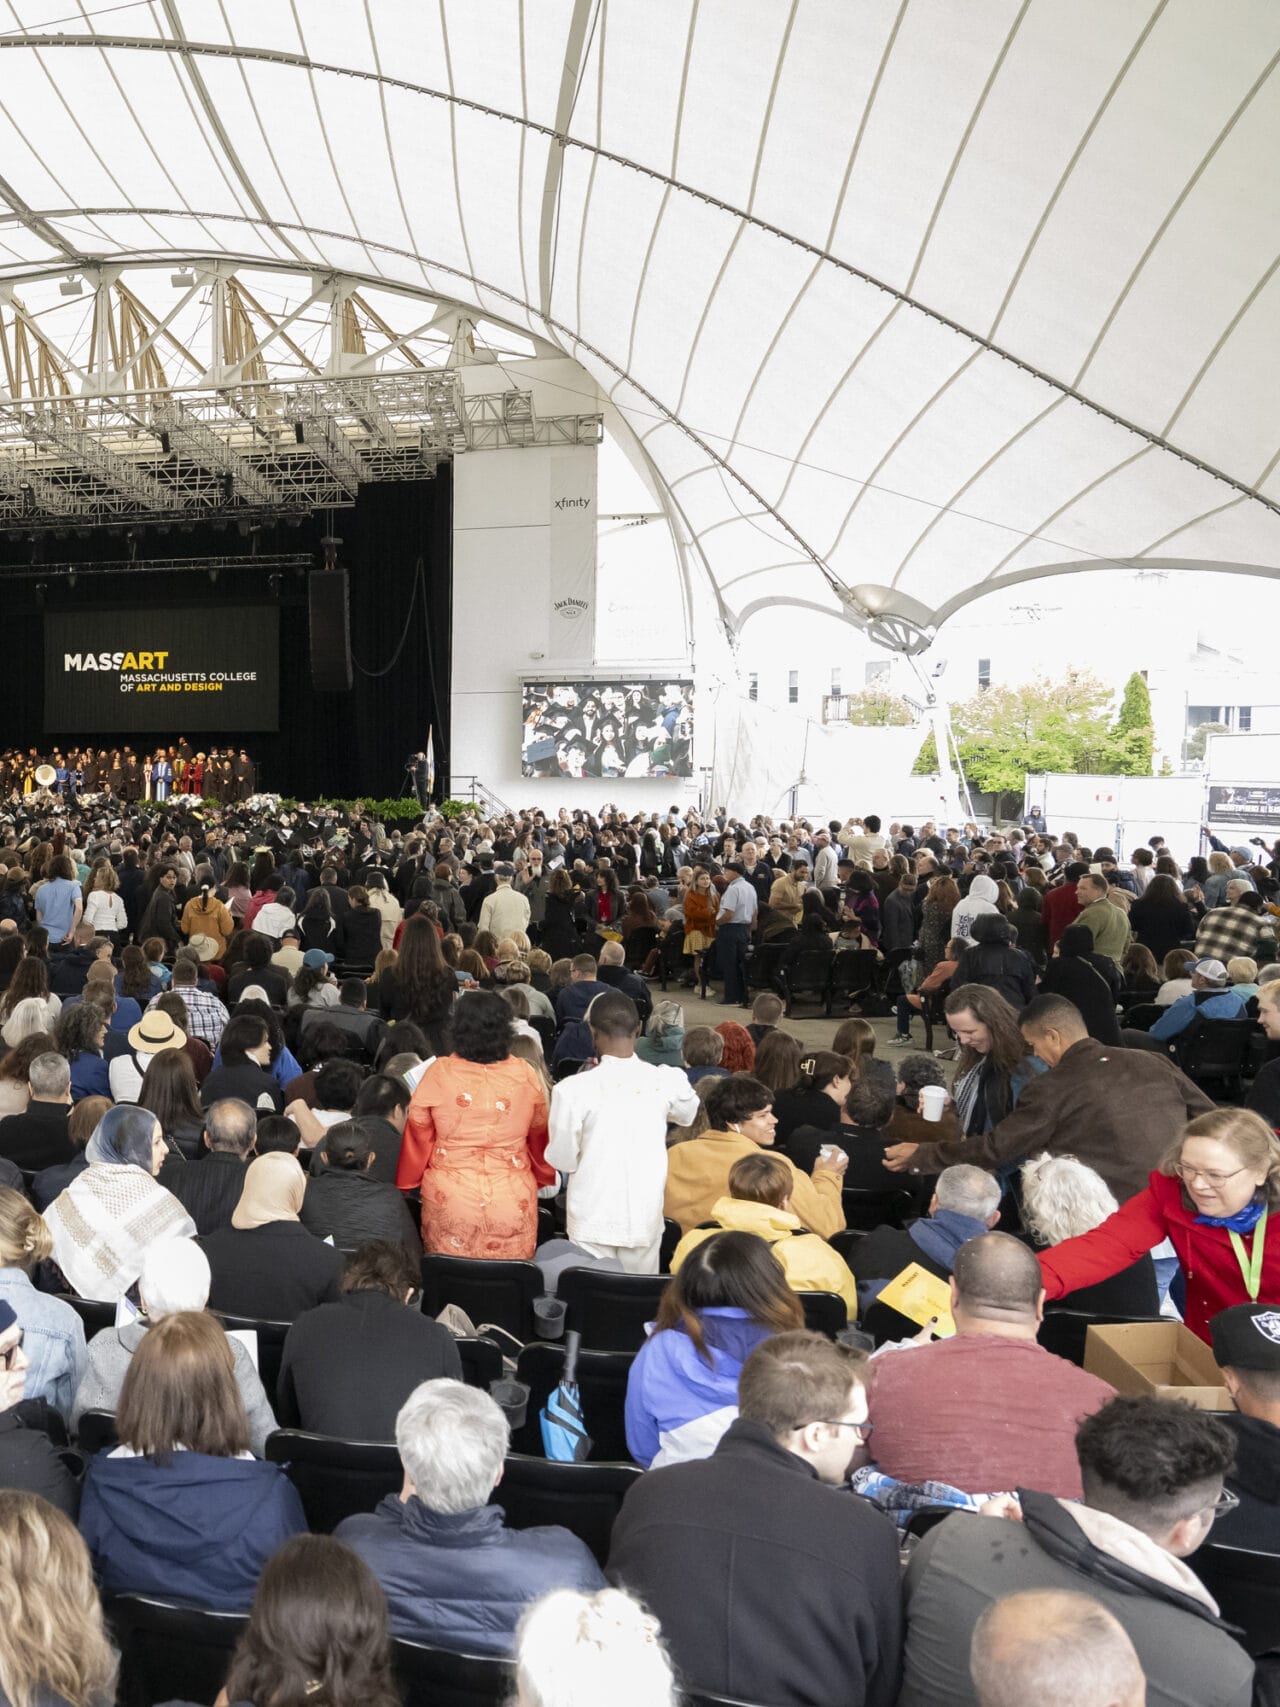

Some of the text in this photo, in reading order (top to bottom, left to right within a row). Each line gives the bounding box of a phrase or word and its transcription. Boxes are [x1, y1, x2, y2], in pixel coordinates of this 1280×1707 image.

[554, 497, 591, 510] xfinity
[64, 651, 169, 671] MASSART
[120, 672, 257, 682] MASSACHUSETTS COLLEGE
[120, 682, 223, 692] OF ART AND DESIGN
